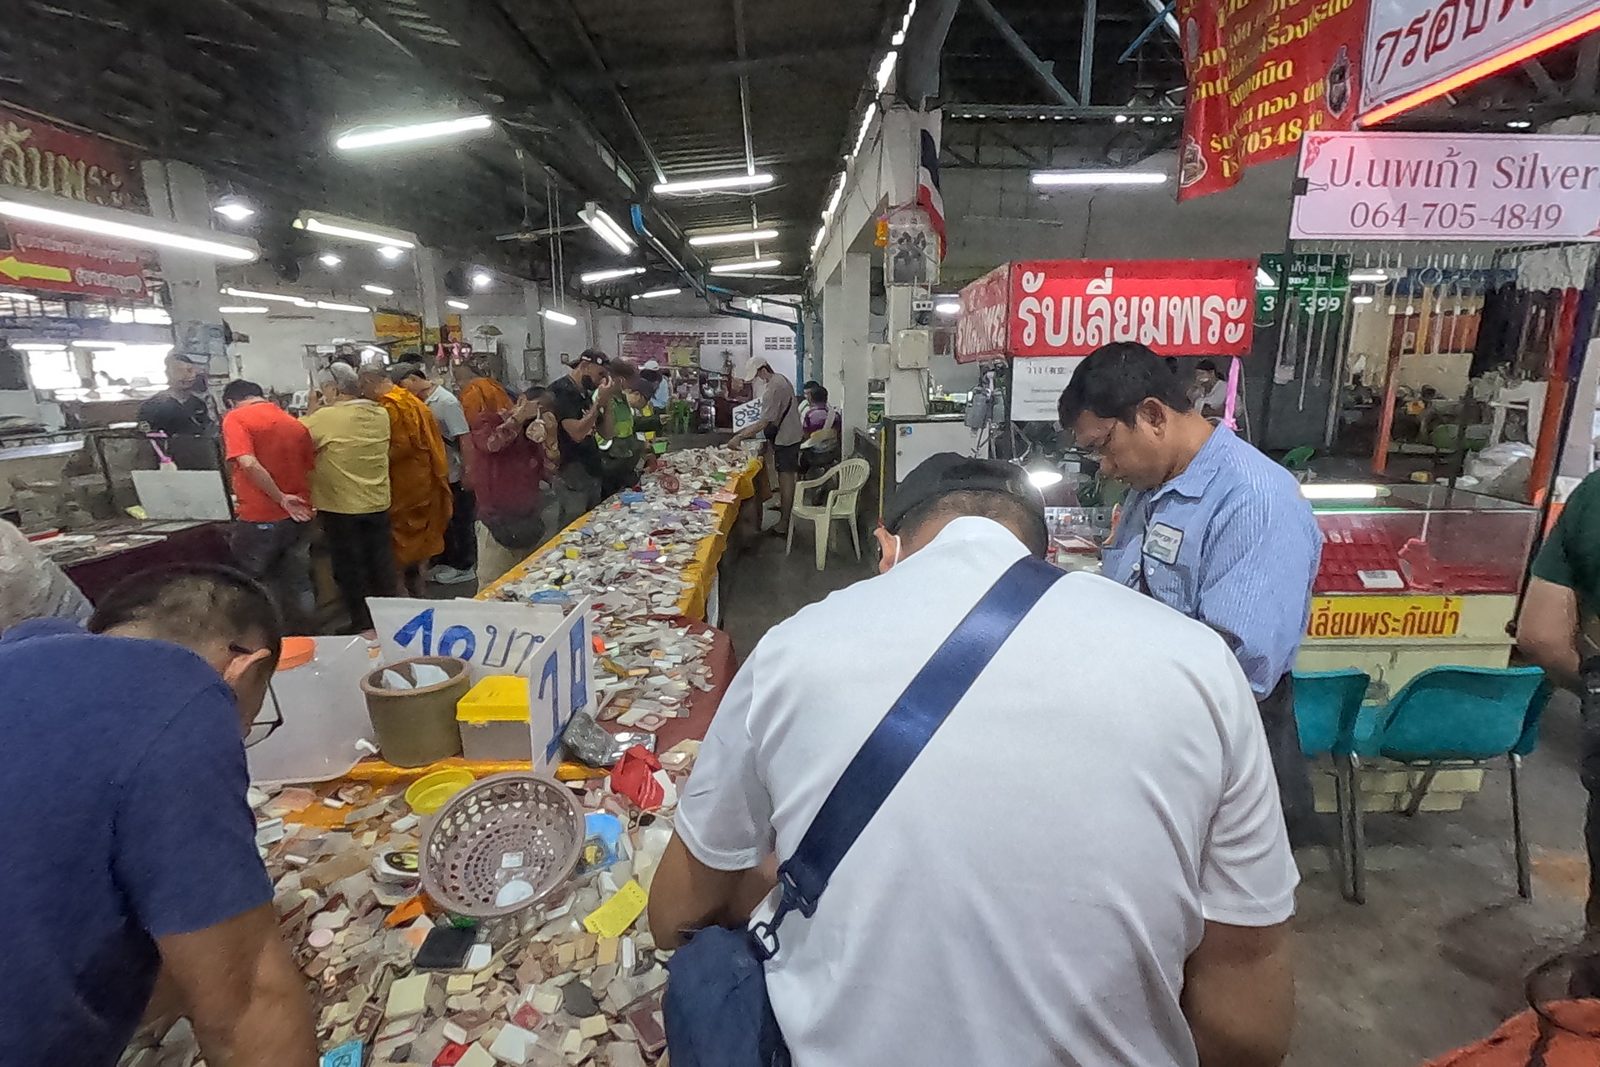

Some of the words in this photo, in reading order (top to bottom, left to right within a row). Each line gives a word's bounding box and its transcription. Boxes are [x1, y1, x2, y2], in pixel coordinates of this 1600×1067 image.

[1329, 145, 1478, 189] ป.นพเก้า
[1493, 153, 1598, 190] Silver
[1350, 202, 1563, 230] 064-705-4849
[1018, 266, 1248, 347] รับเลี่ยมพระ
[1307, 597, 1461, 637] เลี่ยมพระกันน้ำ
